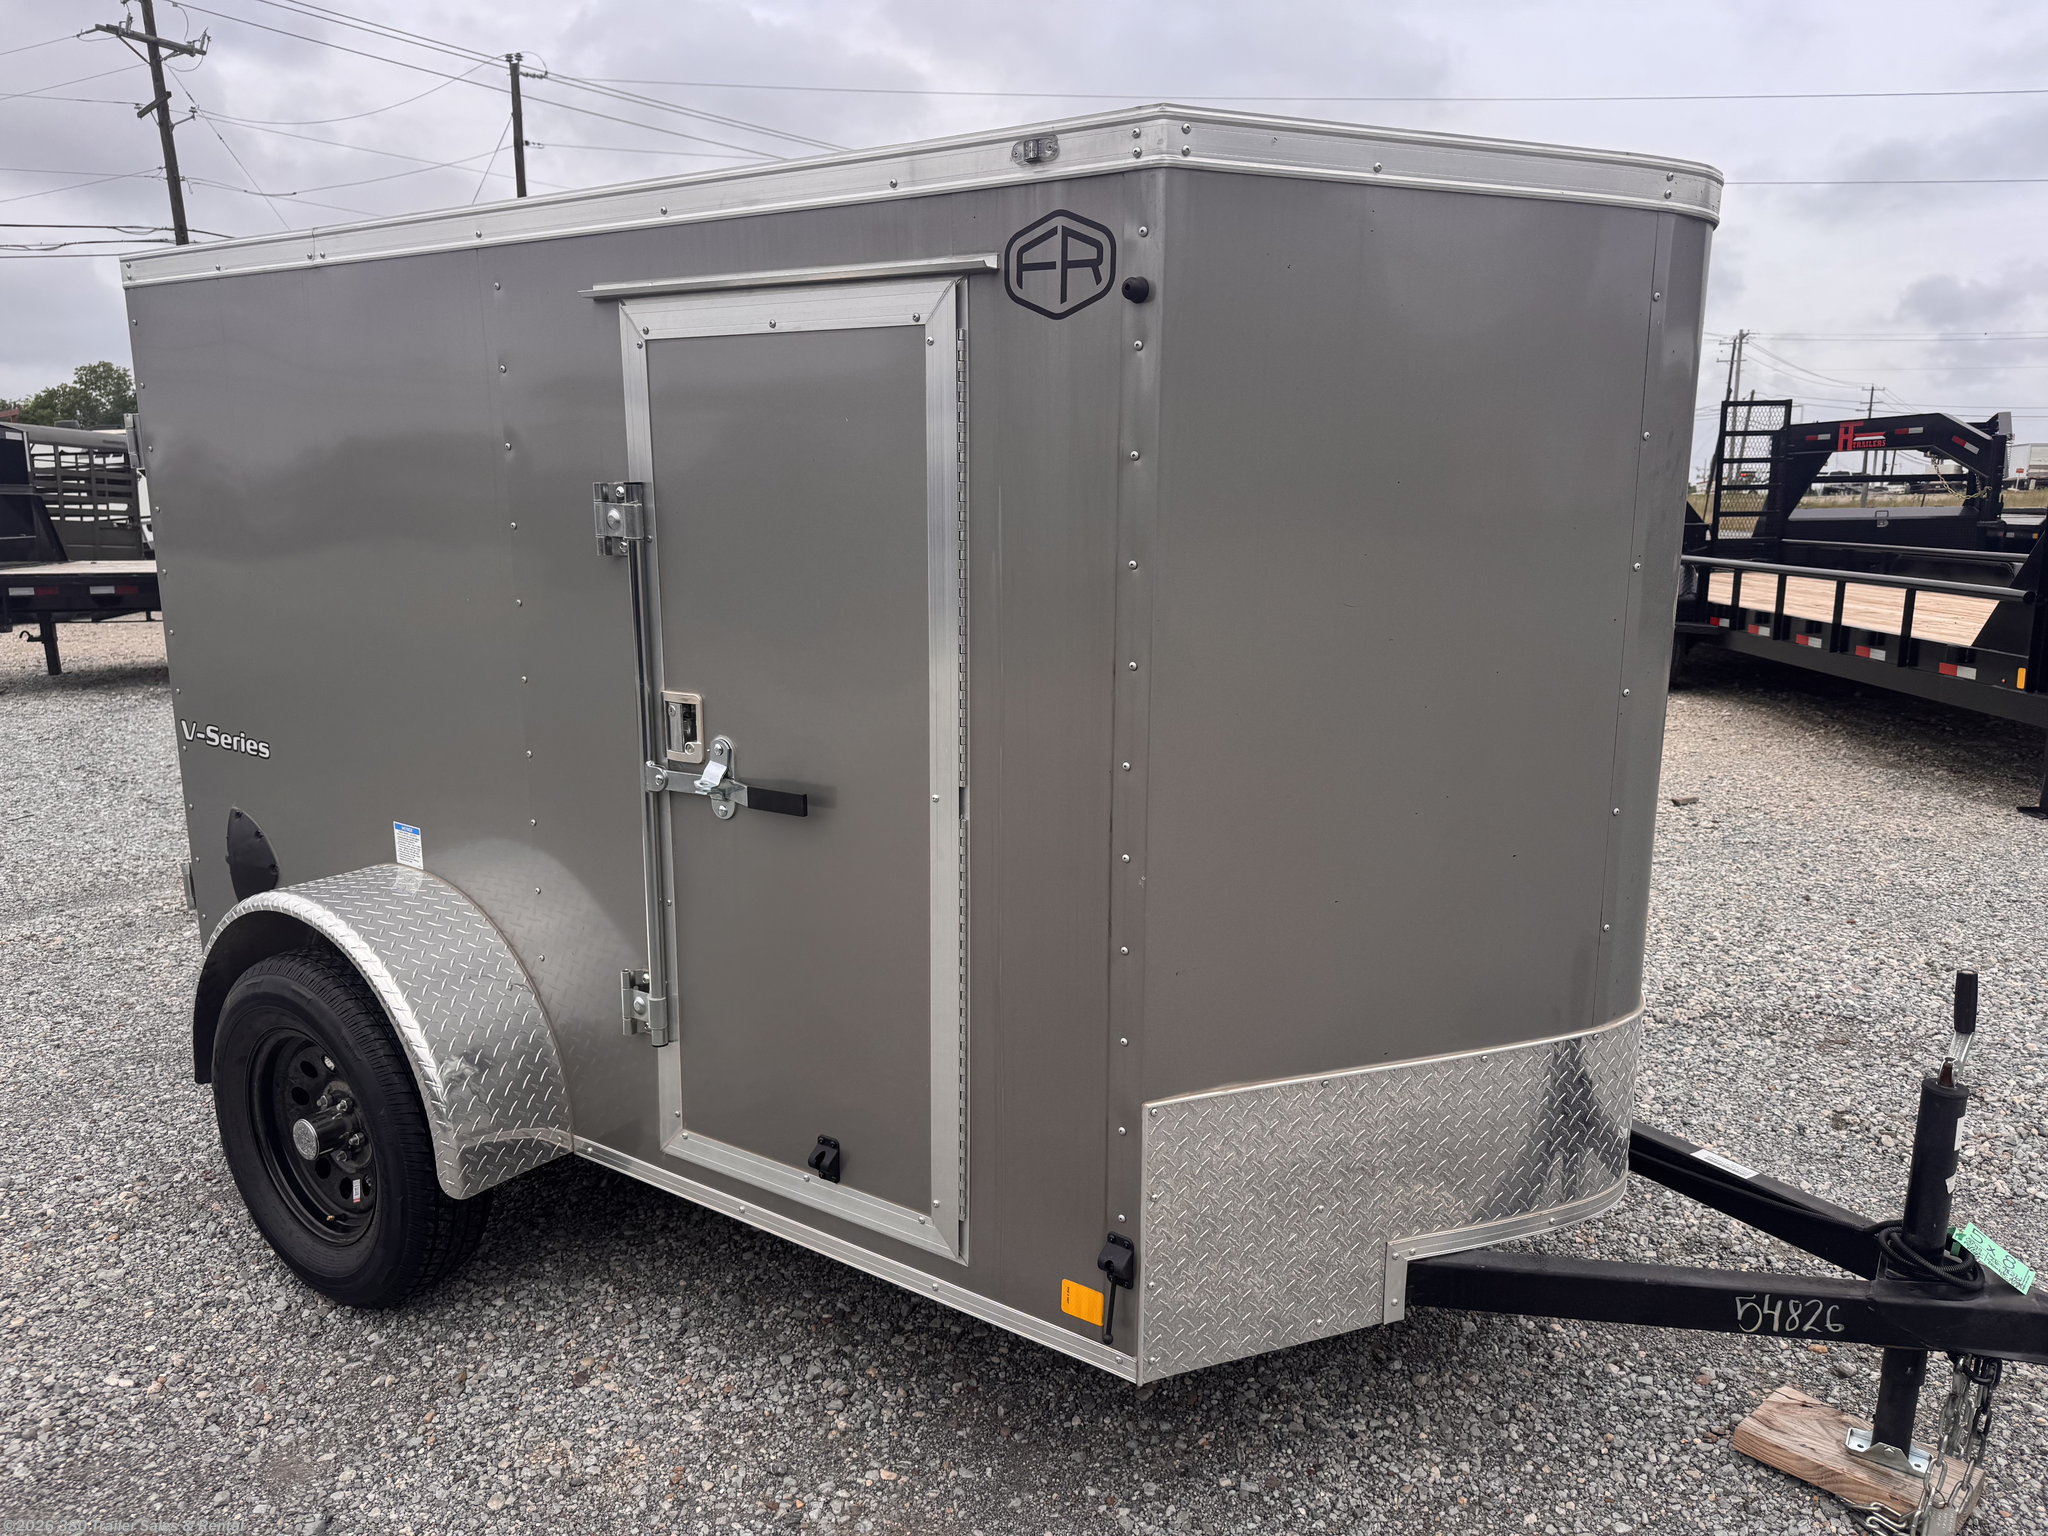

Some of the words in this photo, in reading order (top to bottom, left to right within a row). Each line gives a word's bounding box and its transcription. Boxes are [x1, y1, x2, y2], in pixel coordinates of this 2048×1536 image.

[1852, 440, 1886, 449] TRAILERS
[181, 719, 270, 760] V-Series
[1971, 1228, 1987, 1244] 5
[2002, 1254, 2016, 1270] 8
[1735, 1294, 1845, 1333] 54826
